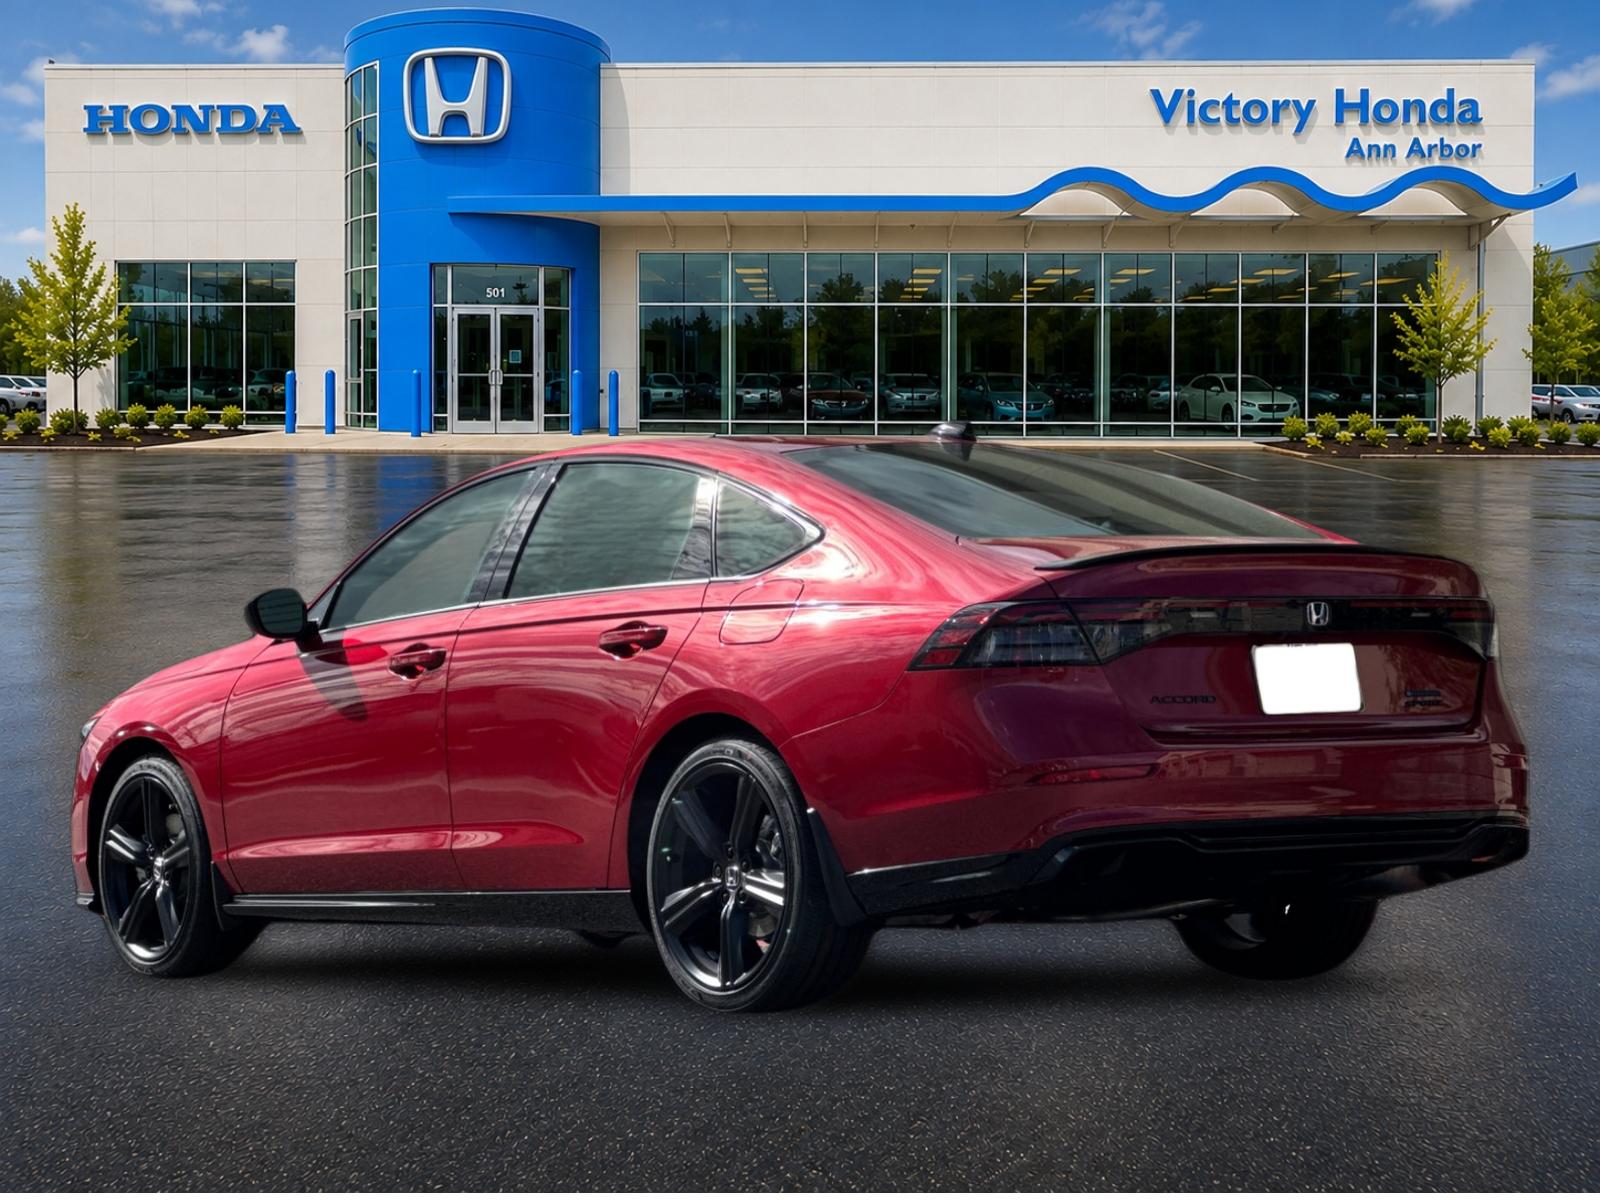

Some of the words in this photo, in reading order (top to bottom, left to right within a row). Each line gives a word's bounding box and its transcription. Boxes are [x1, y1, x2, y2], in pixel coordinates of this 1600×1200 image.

[83, 103, 302, 134] HONDA
[1150, 88, 1316, 134] Victory
[1334, 88, 1483, 125] Honda
[1345, 137, 1396, 159] Ann
[1405, 137, 1482, 159] Arbor
[485, 287, 505, 298] 501
[1149, 695, 1217, 704] ACCORD
